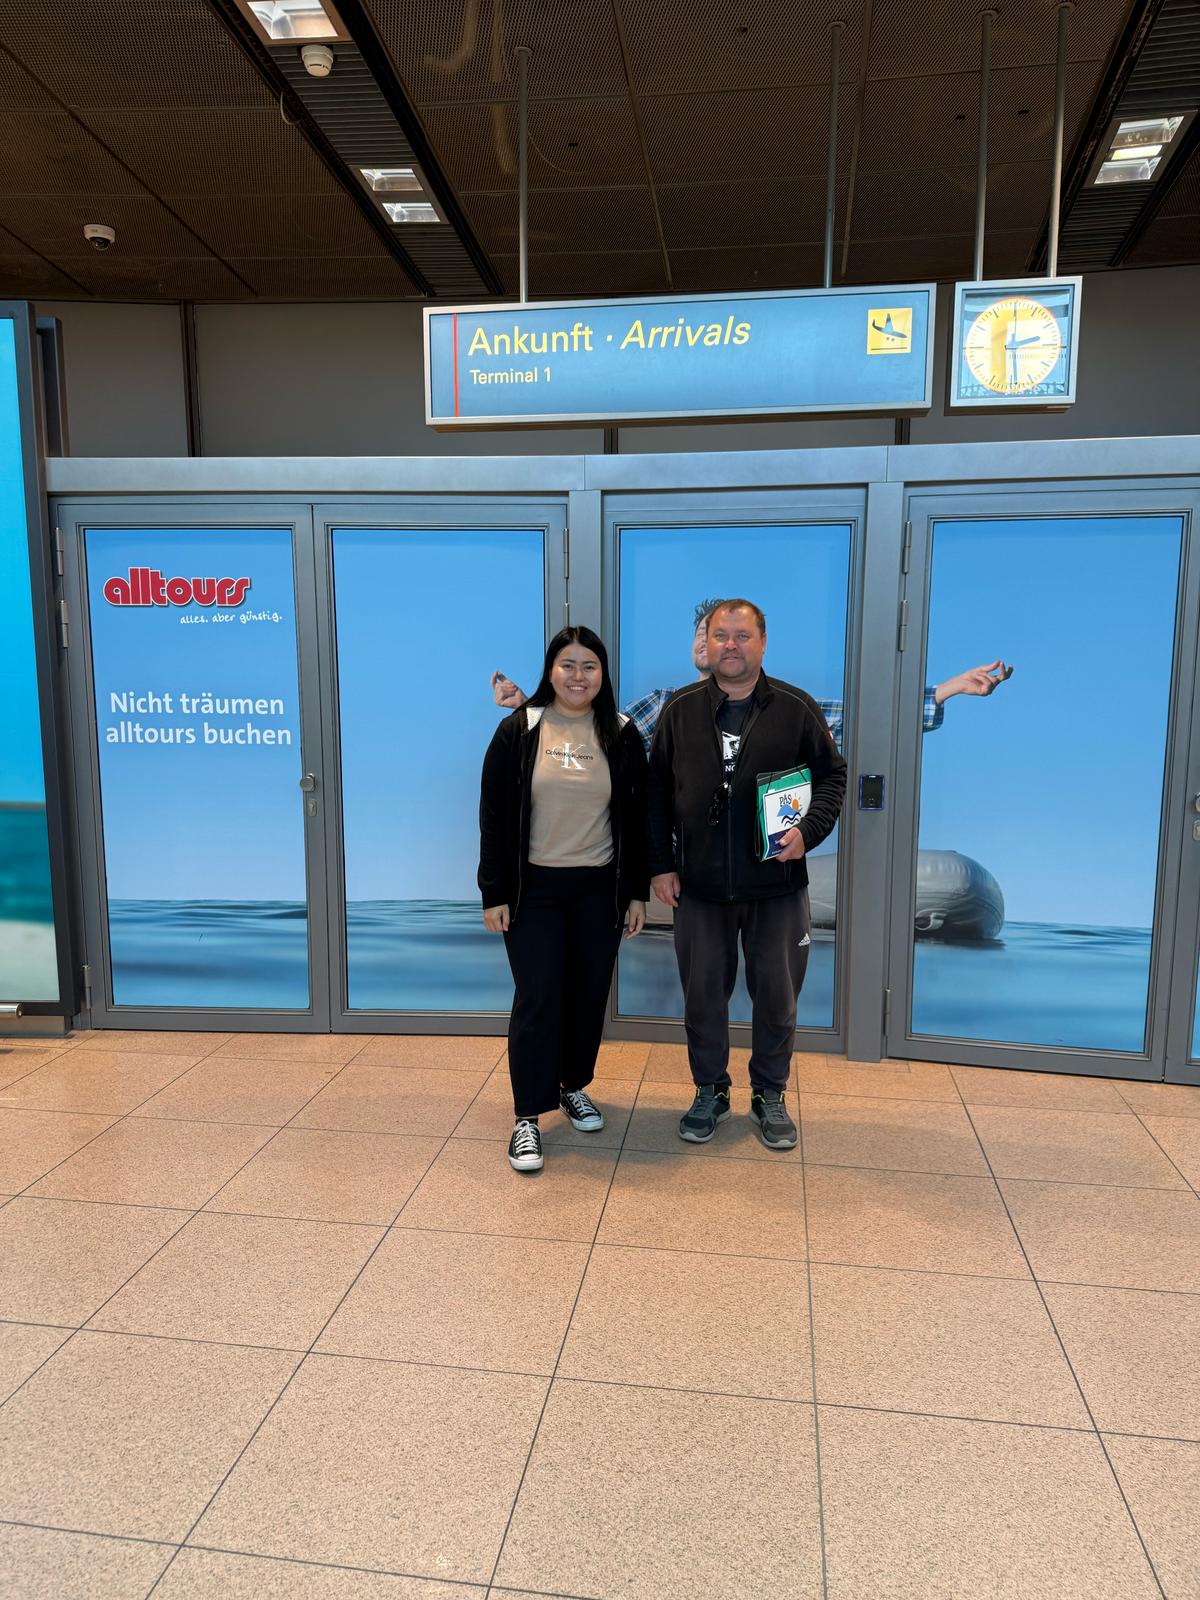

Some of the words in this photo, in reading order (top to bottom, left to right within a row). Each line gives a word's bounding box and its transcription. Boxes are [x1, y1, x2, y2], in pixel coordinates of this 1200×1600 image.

[468, 322, 594, 356] Ankunft
[620, 316, 751, 350] Arrivals
[469, 368, 538, 385] Terminal
[543, 367, 551, 382] 1
[103, 566, 252, 607] alltours
[212, 612, 236, 623] aber
[240, 610, 283, 625] günstig.
[110, 691, 174, 714] Nicht
[180, 692, 285, 715] träumen
[106, 720, 197, 744] alltours
[203, 722, 292, 746] buchen
